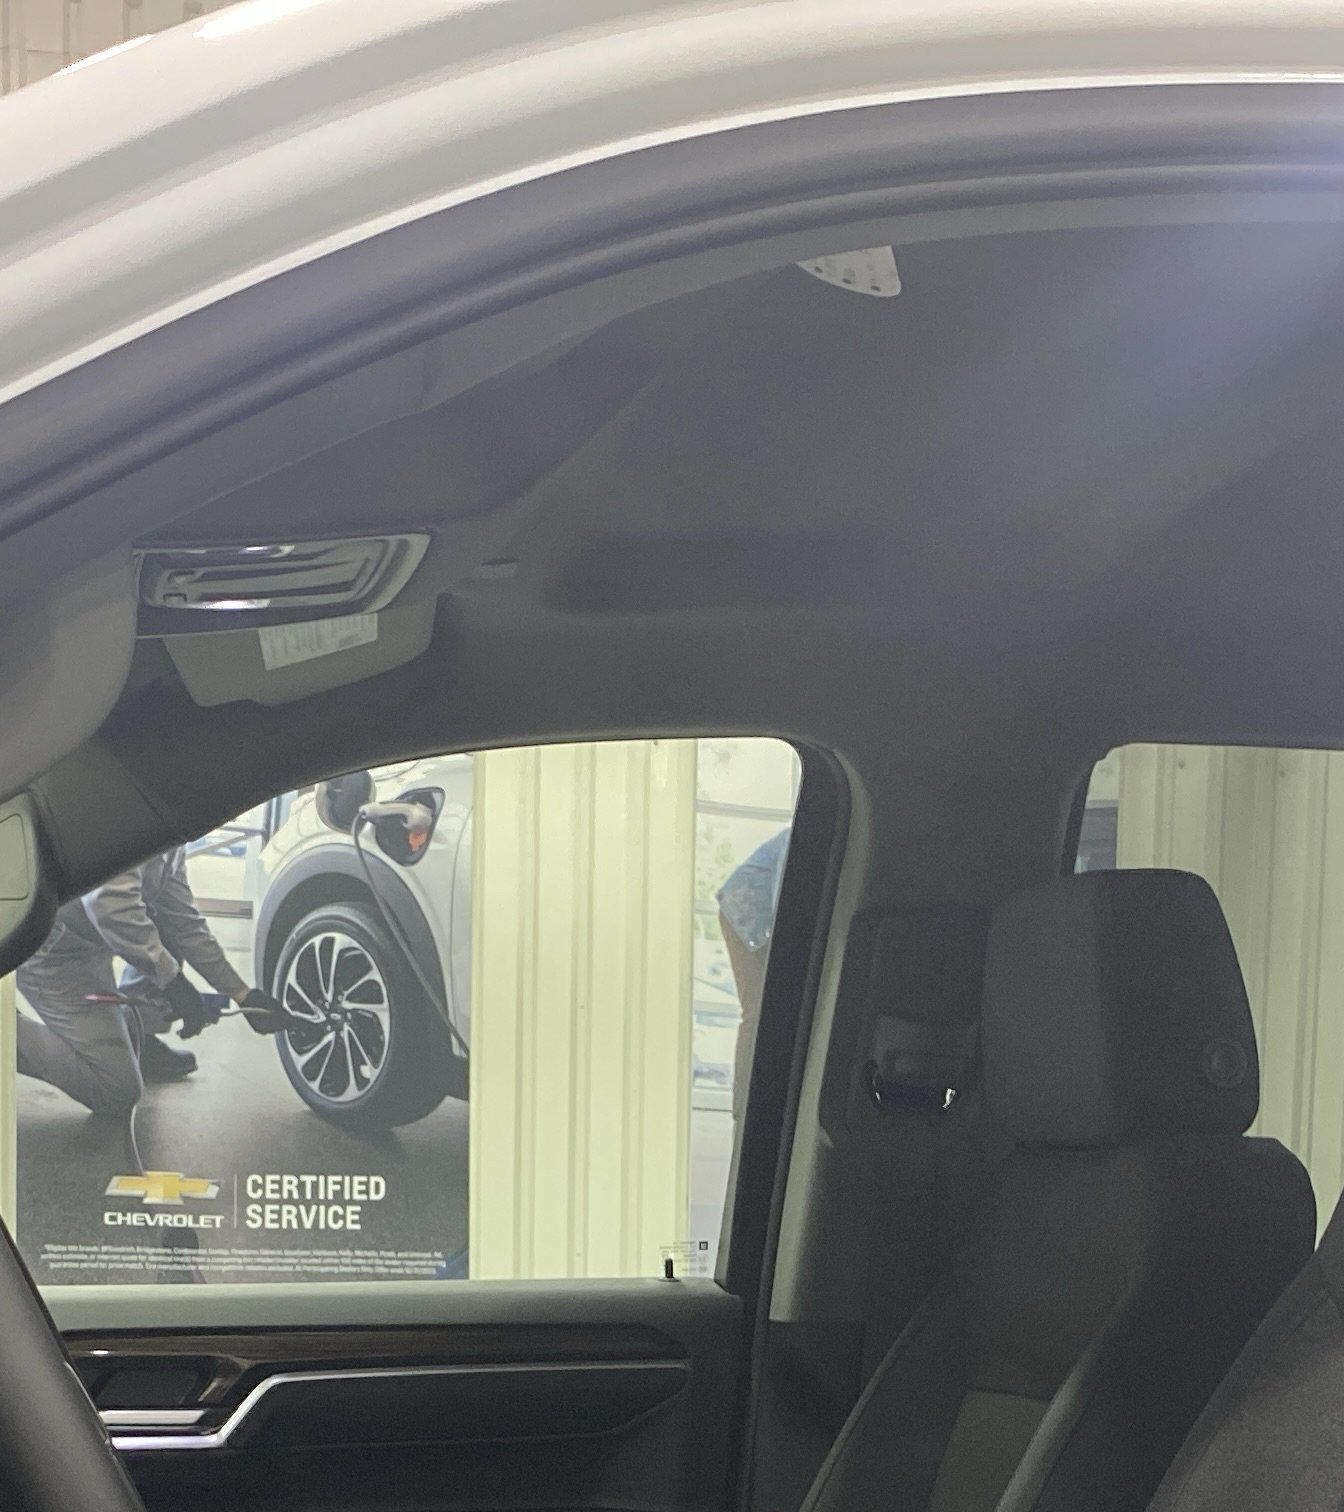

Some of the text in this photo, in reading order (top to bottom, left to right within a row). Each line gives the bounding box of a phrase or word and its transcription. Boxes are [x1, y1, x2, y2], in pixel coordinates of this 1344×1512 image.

[246, 1174, 387, 1201] CERTIFIED
[103, 1212, 225, 1229] CHEVROLET
[246, 1204, 362, 1230] SERVICE
